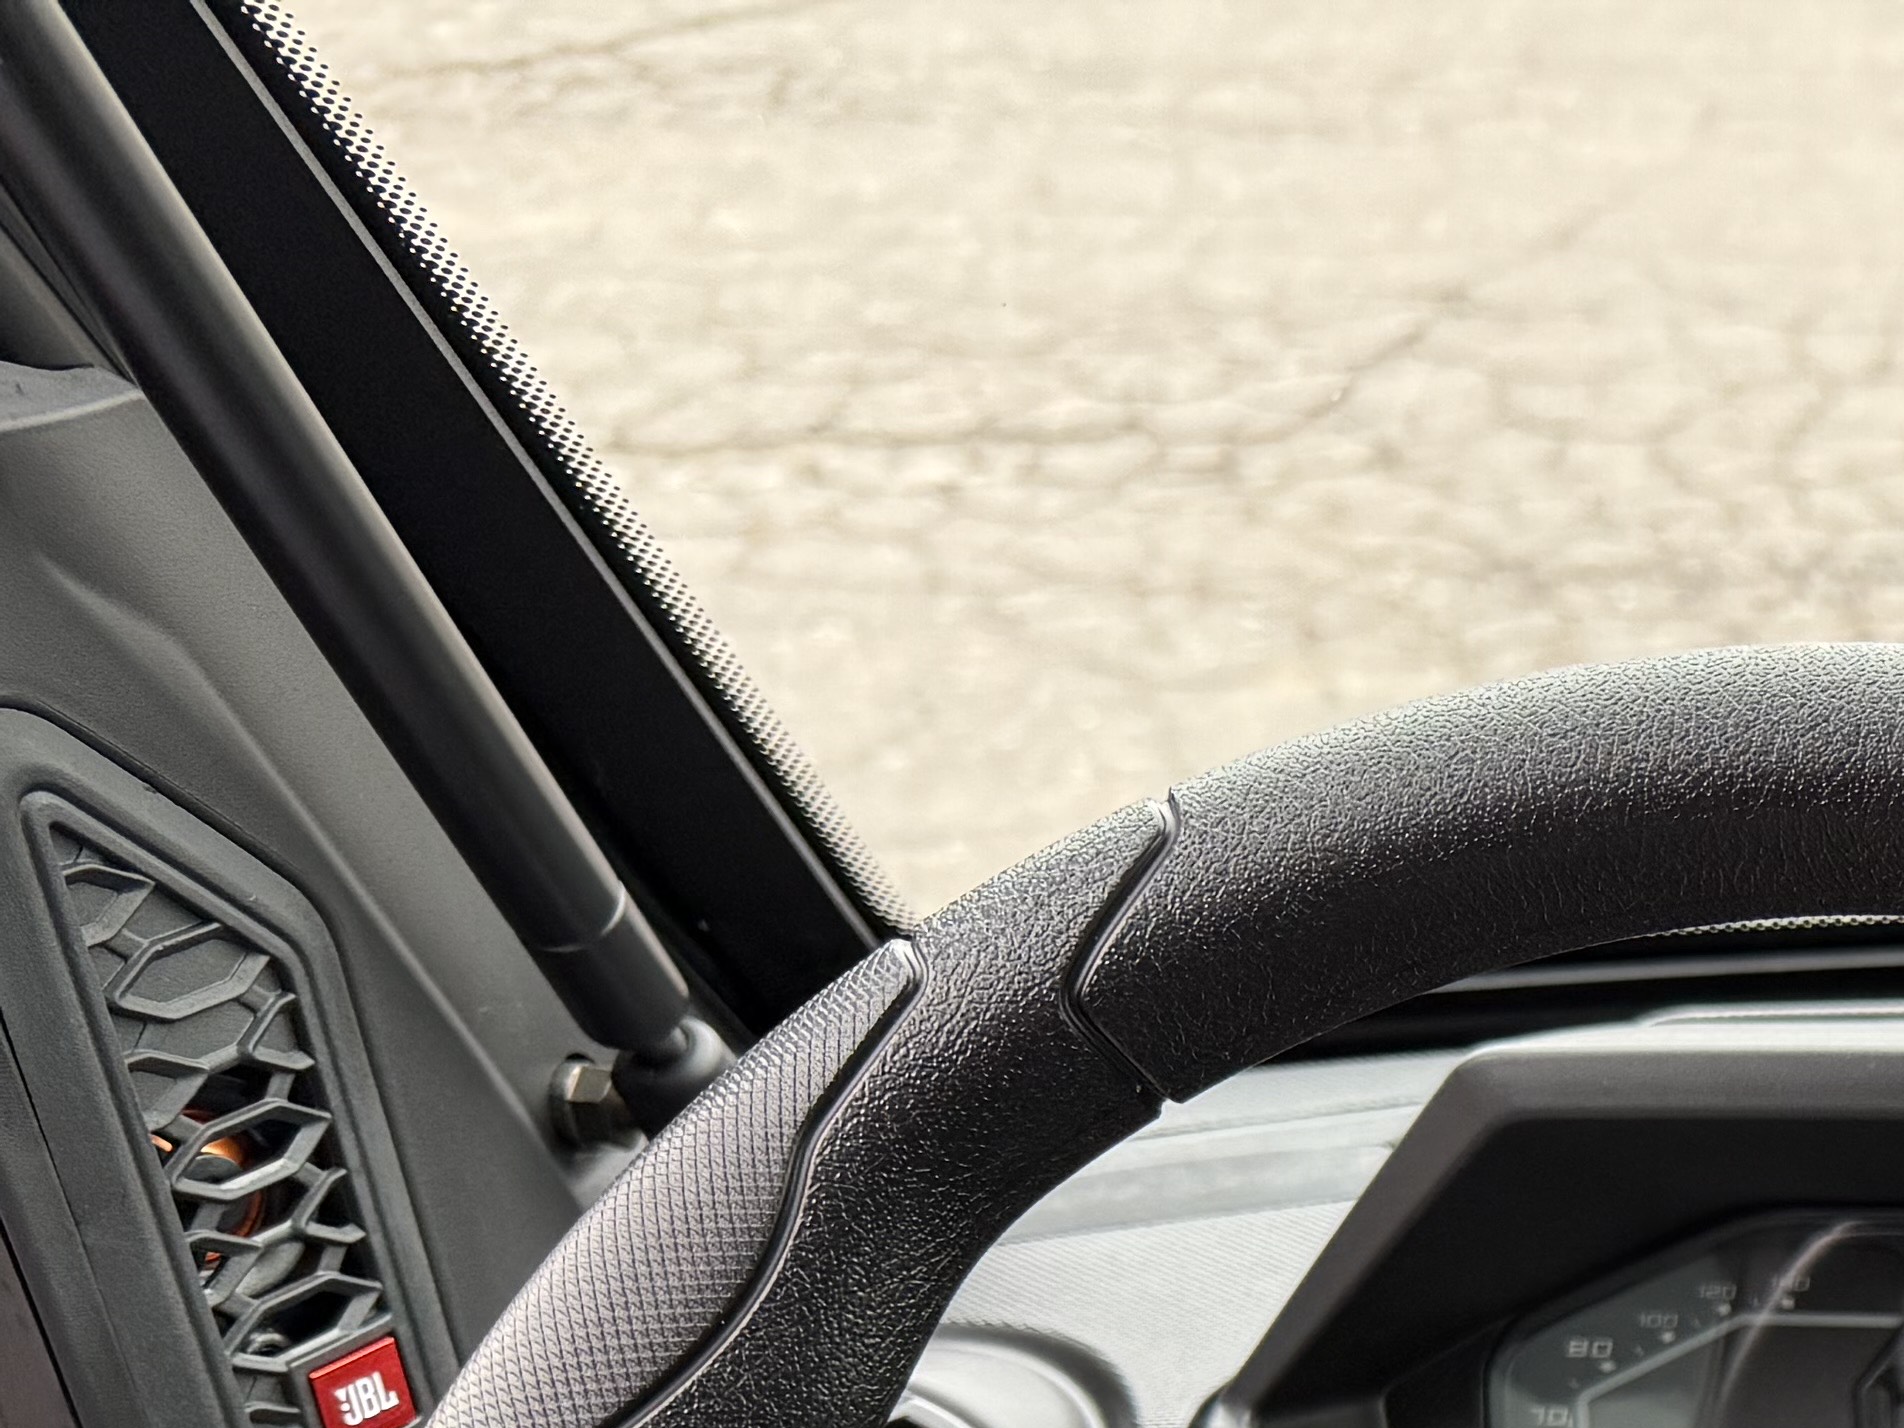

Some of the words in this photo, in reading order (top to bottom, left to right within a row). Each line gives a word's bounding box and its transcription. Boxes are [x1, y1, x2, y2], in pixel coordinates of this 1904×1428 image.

[1566, 1335, 1614, 1359] 80
[334, 1371, 400, 1426] JBL
[1529, 1405, 1570, 1428] 70
